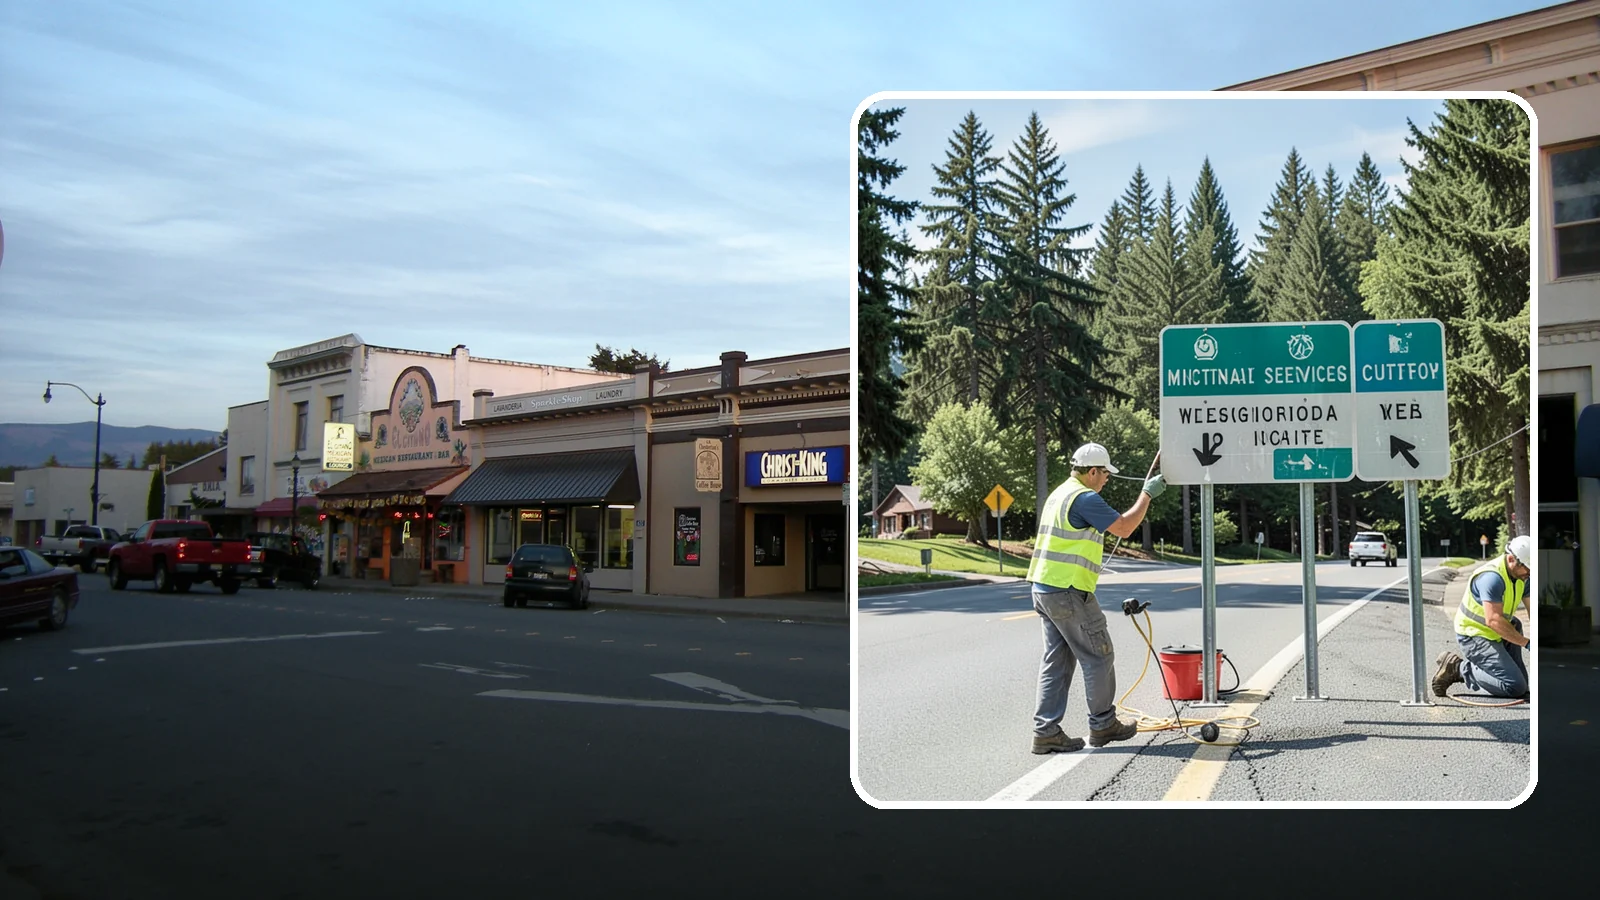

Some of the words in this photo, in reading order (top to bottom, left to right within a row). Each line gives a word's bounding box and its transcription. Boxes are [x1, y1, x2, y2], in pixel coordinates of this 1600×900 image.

[595, 388, 624, 400] LAUNDRY
[493, 401, 523, 413] LAVANDERIA
[373, 454, 396, 464] MEXICAN
[397, 452, 433, 462] RESTAURANT
[438, 450, 450, 459] BAR
[761, 452, 797, 478] CHRIST
[799, 449, 827, 476] KING
[696, 480, 709, 489] Coffee
[710, 480, 722, 489] House
